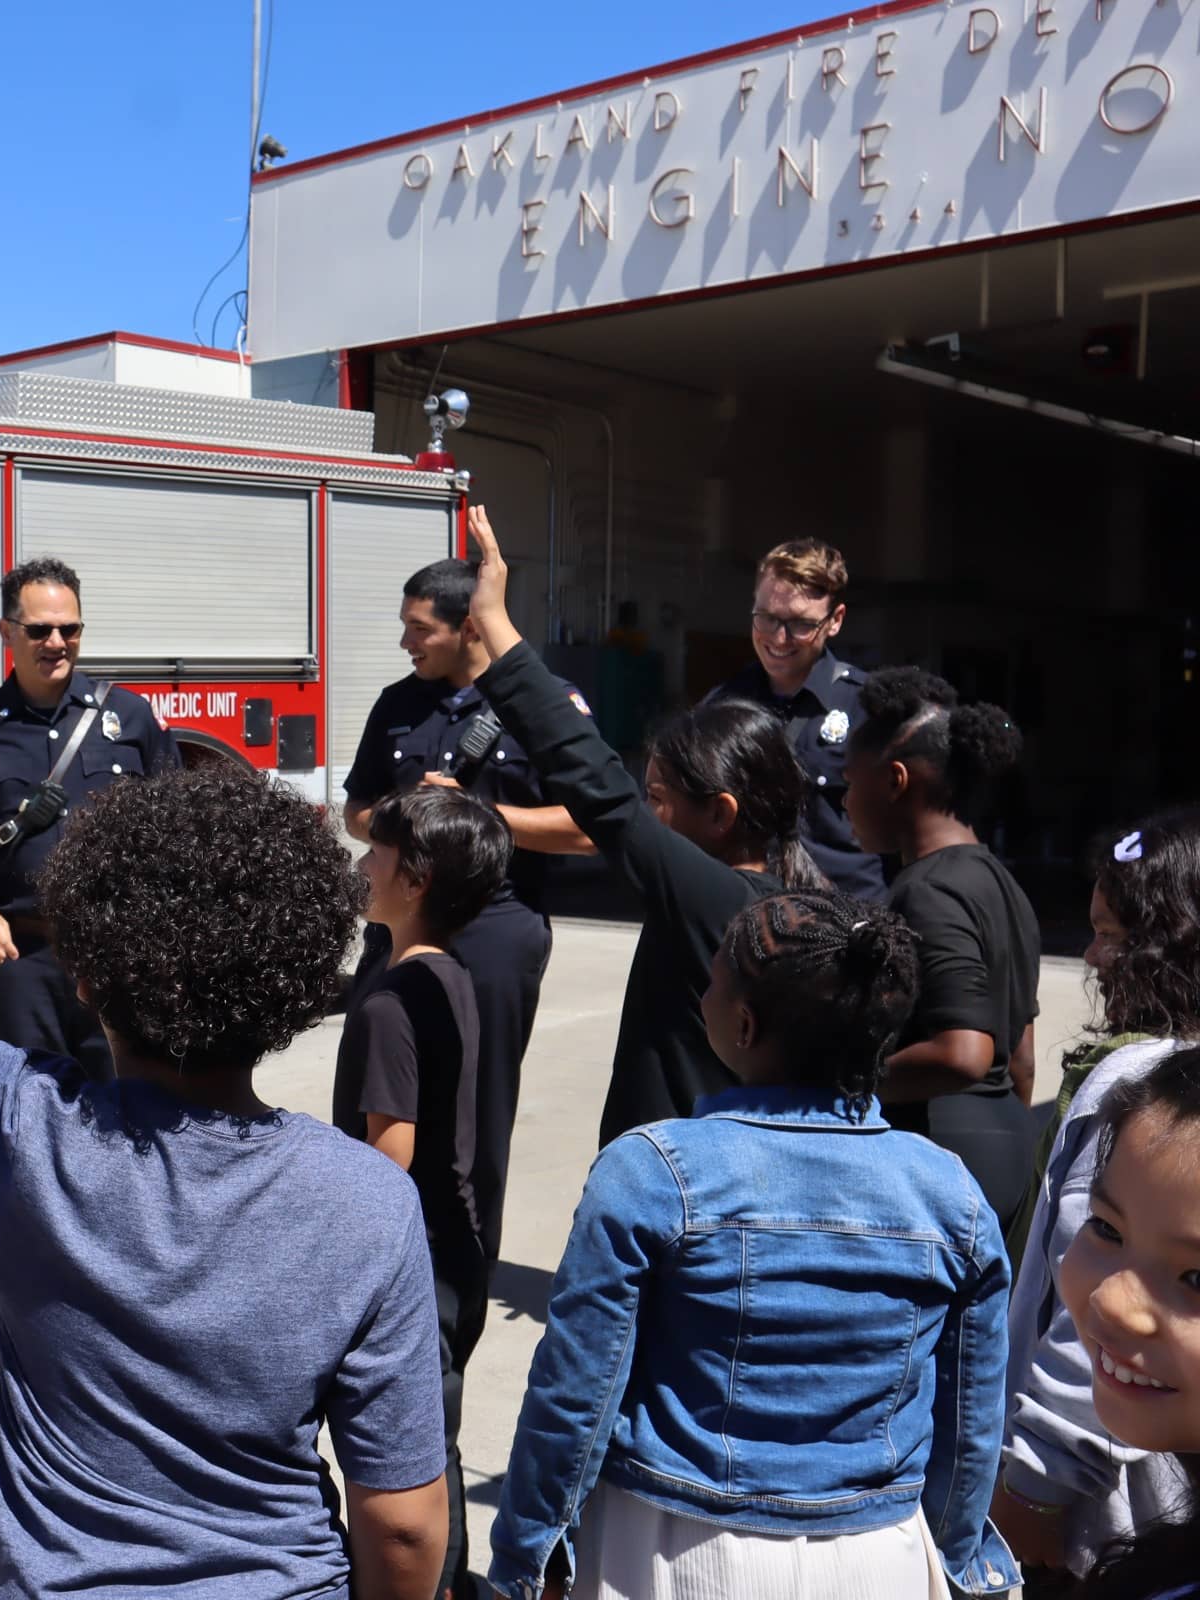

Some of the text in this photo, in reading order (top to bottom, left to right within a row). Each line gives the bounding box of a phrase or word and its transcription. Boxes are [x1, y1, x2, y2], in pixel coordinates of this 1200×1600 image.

[403, 91, 682, 190] OAKLAND
[739, 31, 898, 112] FIRE
[521, 122, 892, 258] ENGINE
[140, 692, 237, 719] AMEDIC UNIT
